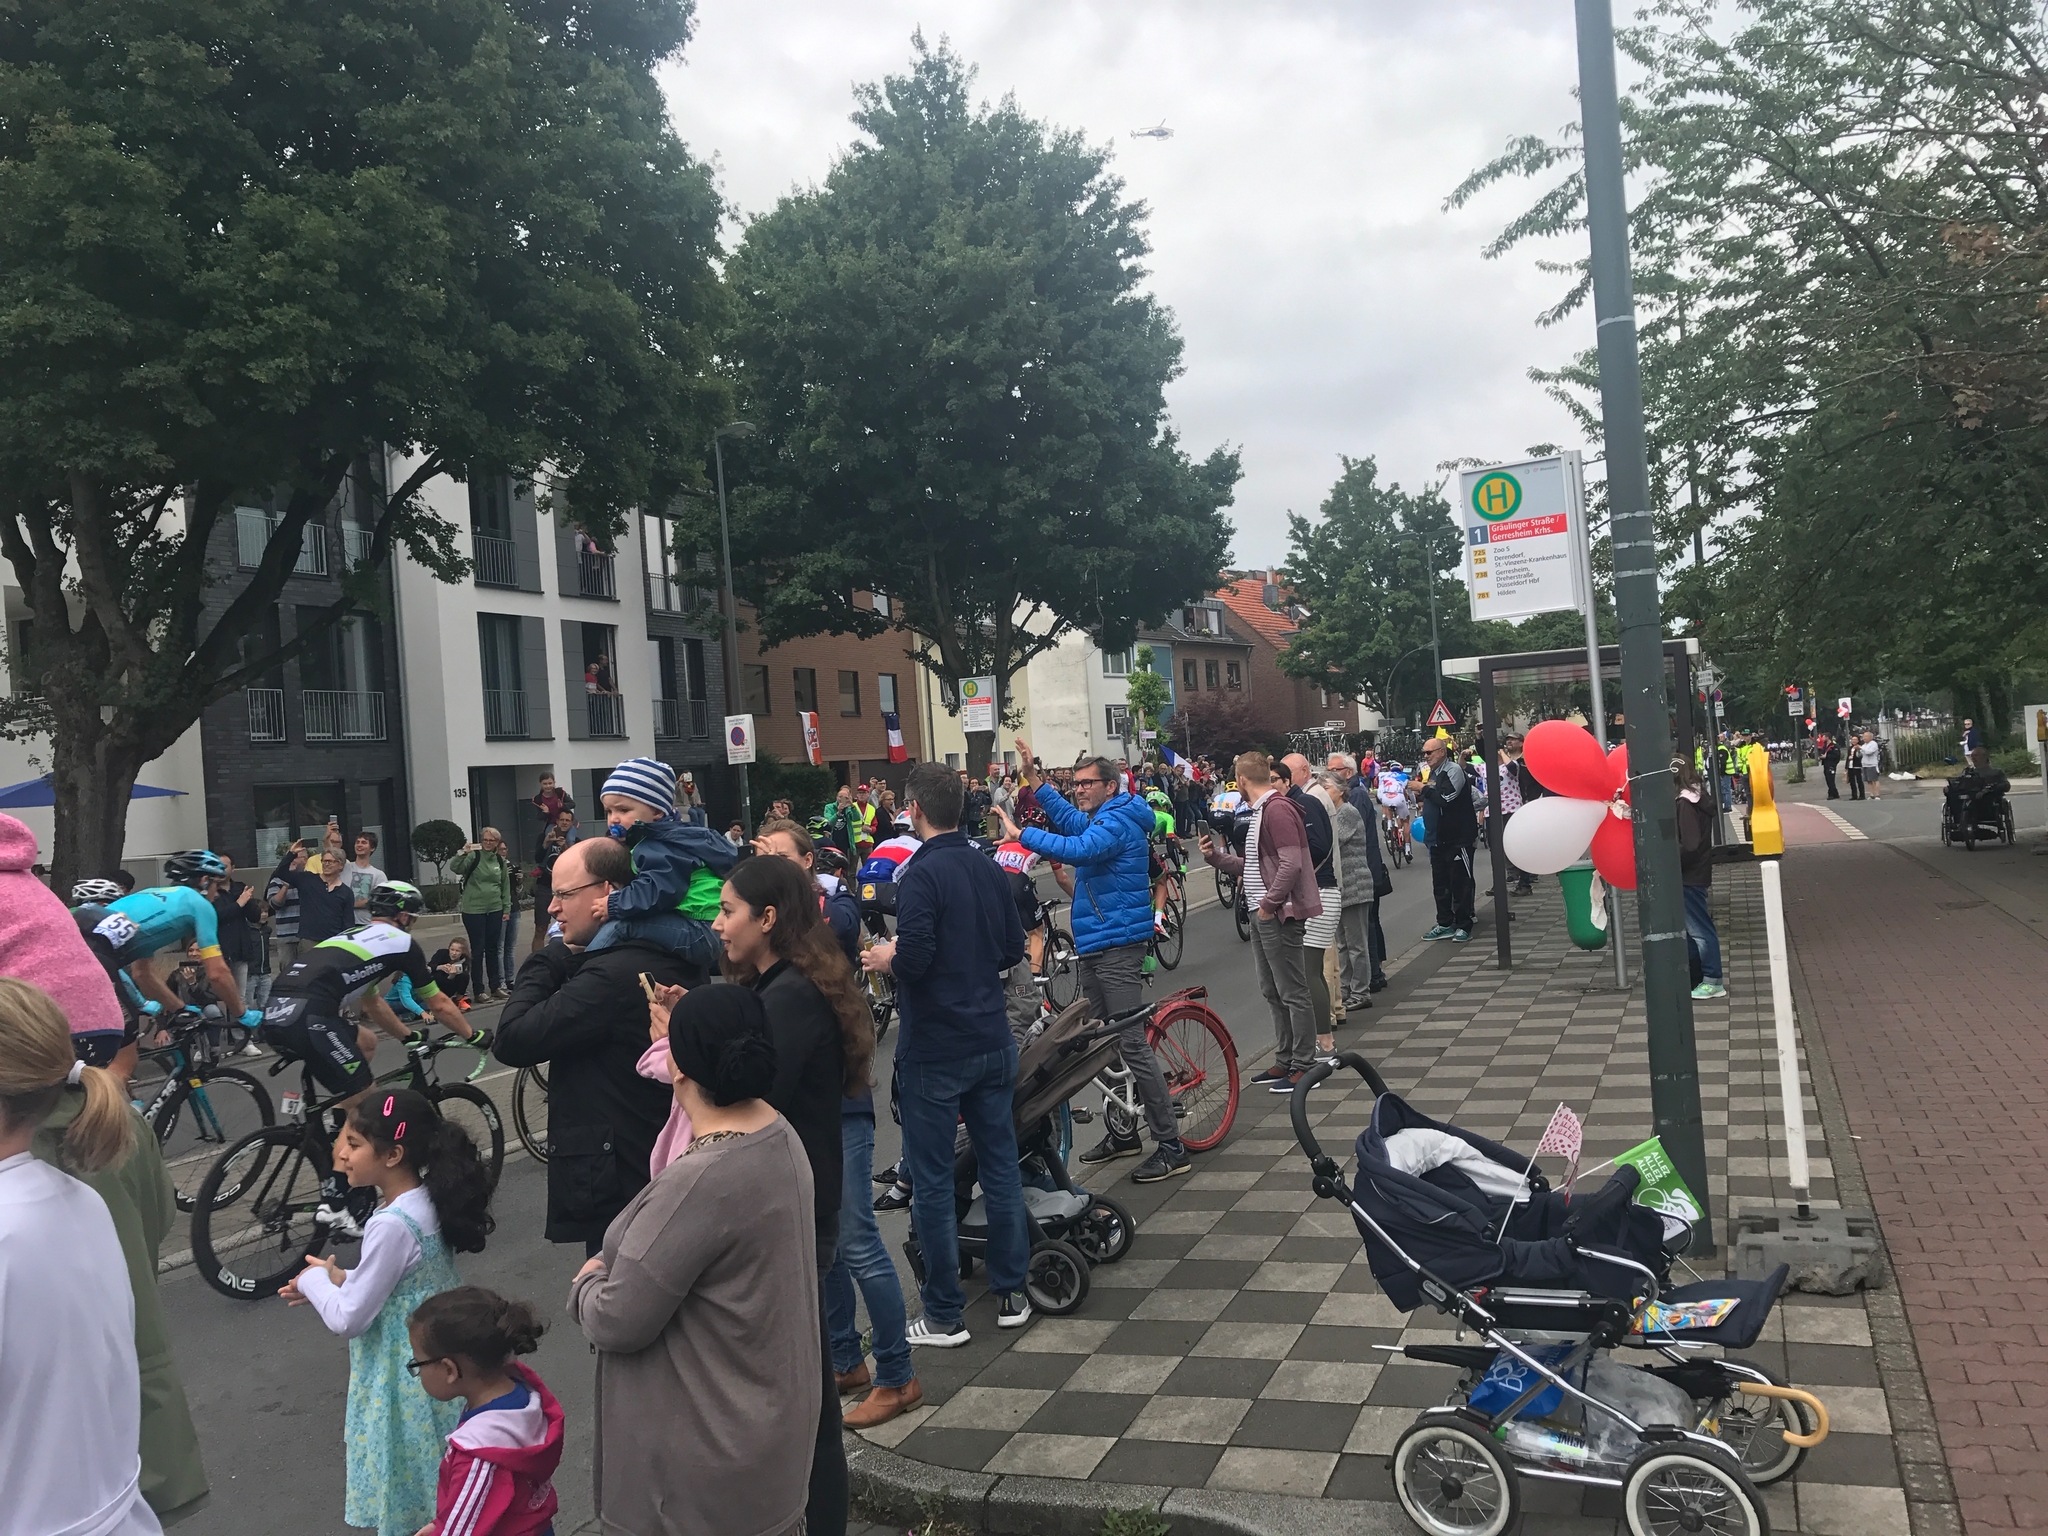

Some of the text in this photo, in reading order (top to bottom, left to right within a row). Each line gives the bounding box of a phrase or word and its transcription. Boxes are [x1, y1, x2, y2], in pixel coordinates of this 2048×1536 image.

[1486, 481, 1508, 512] H
[1491, 521, 1528, 532] Gräulinger
[1531, 516, 1555, 527] Straße
[1474, 528, 1482, 543] 1
[1492, 526, 1553, 541] Gerresheim Krhs.
[1494, 552, 1525, 561] Derendorf,
[1475, 571, 1488, 579] 738
[1495, 567, 1530, 576] Gerresheim,
[1496, 572, 1534, 582] Dreherstraße
[1496, 579, 1528, 588] Düsseldorf
[967, 683, 975, 695] H
[453, 787, 467, 798] 135
[1006, 851, 1024, 863] 137
[107, 916, 135, 939] 55
[326, 1031, 355, 1061] dimension
[330, 1050, 347, 1065] data
[1643, 1155, 1664, 1182] ALLEZ,
[1651, 1151, 1671, 1178] ALLEZ,
[1636, 1159, 1657, 1186] ALLEZ!
